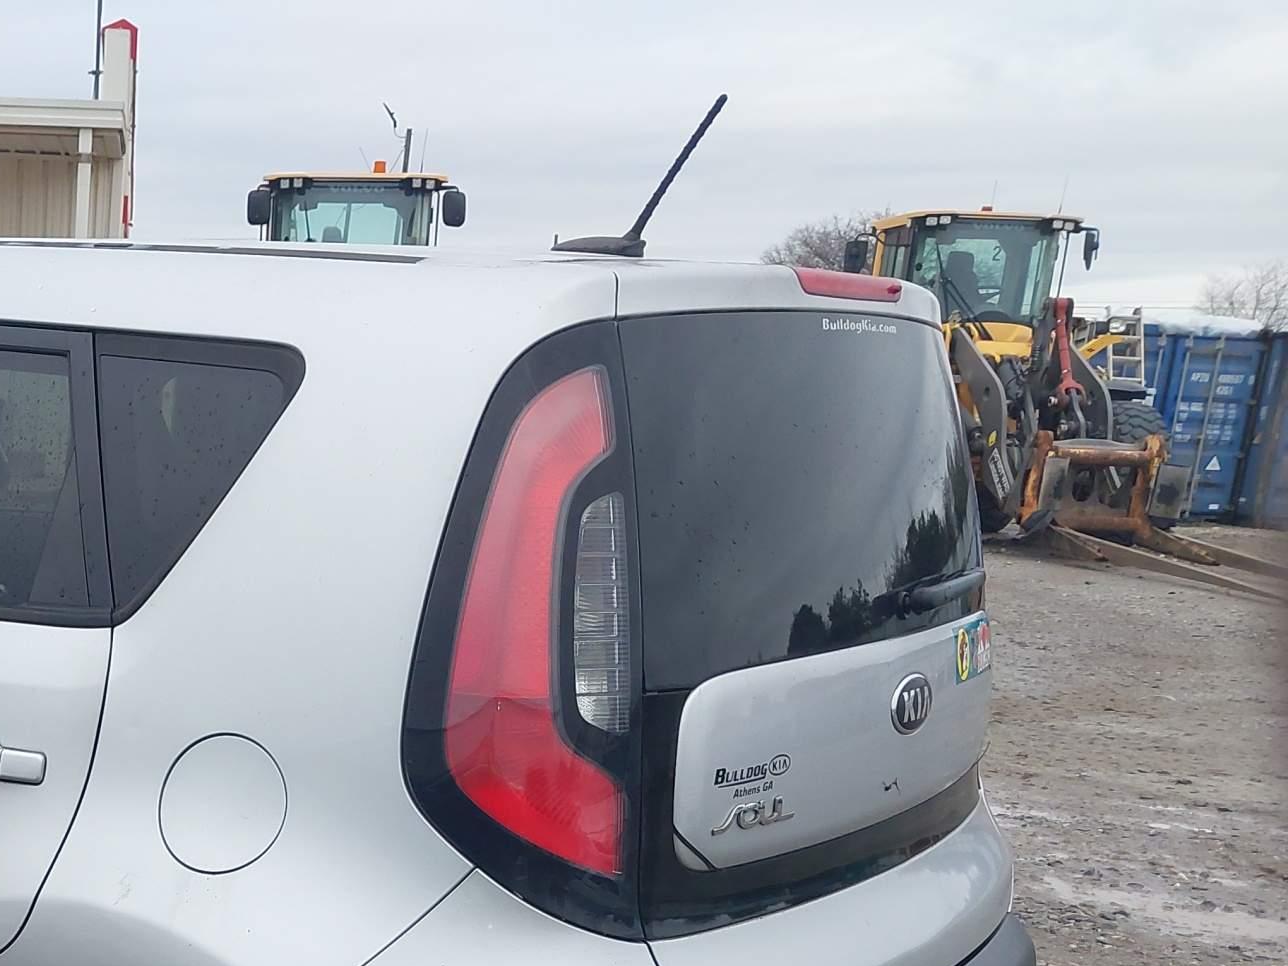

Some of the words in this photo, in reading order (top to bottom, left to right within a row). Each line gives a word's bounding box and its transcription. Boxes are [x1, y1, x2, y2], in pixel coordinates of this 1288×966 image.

[992, 246, 1002, 261] 2
[822, 318, 897, 334] BulldogKia.com
[902, 686, 930, 723] KIA
[772, 759, 788, 772] KIA
[732, 786, 761, 799] Athens
[762, 780, 774, 792] GA
[711, 795, 795, 836] SOUL
